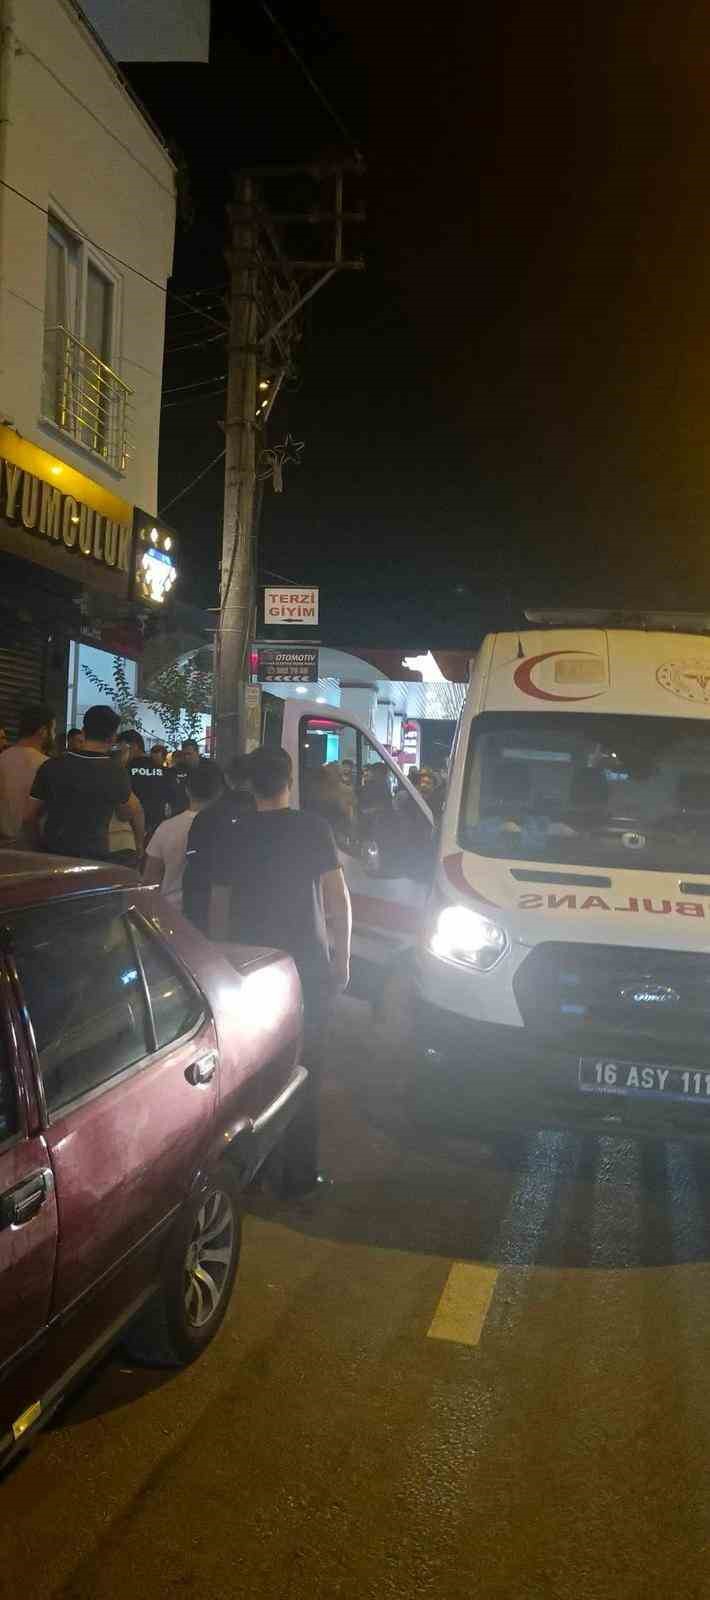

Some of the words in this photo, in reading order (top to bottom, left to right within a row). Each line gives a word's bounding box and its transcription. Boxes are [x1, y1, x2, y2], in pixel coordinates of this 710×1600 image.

[0, 462, 131, 571] YUMCULUK
[269, 592, 315, 604] TERZİ
[270, 605, 315, 617] GİYİM
[595, 1063, 617, 1085] 16
[625, 1066, 669, 1091] ASY
